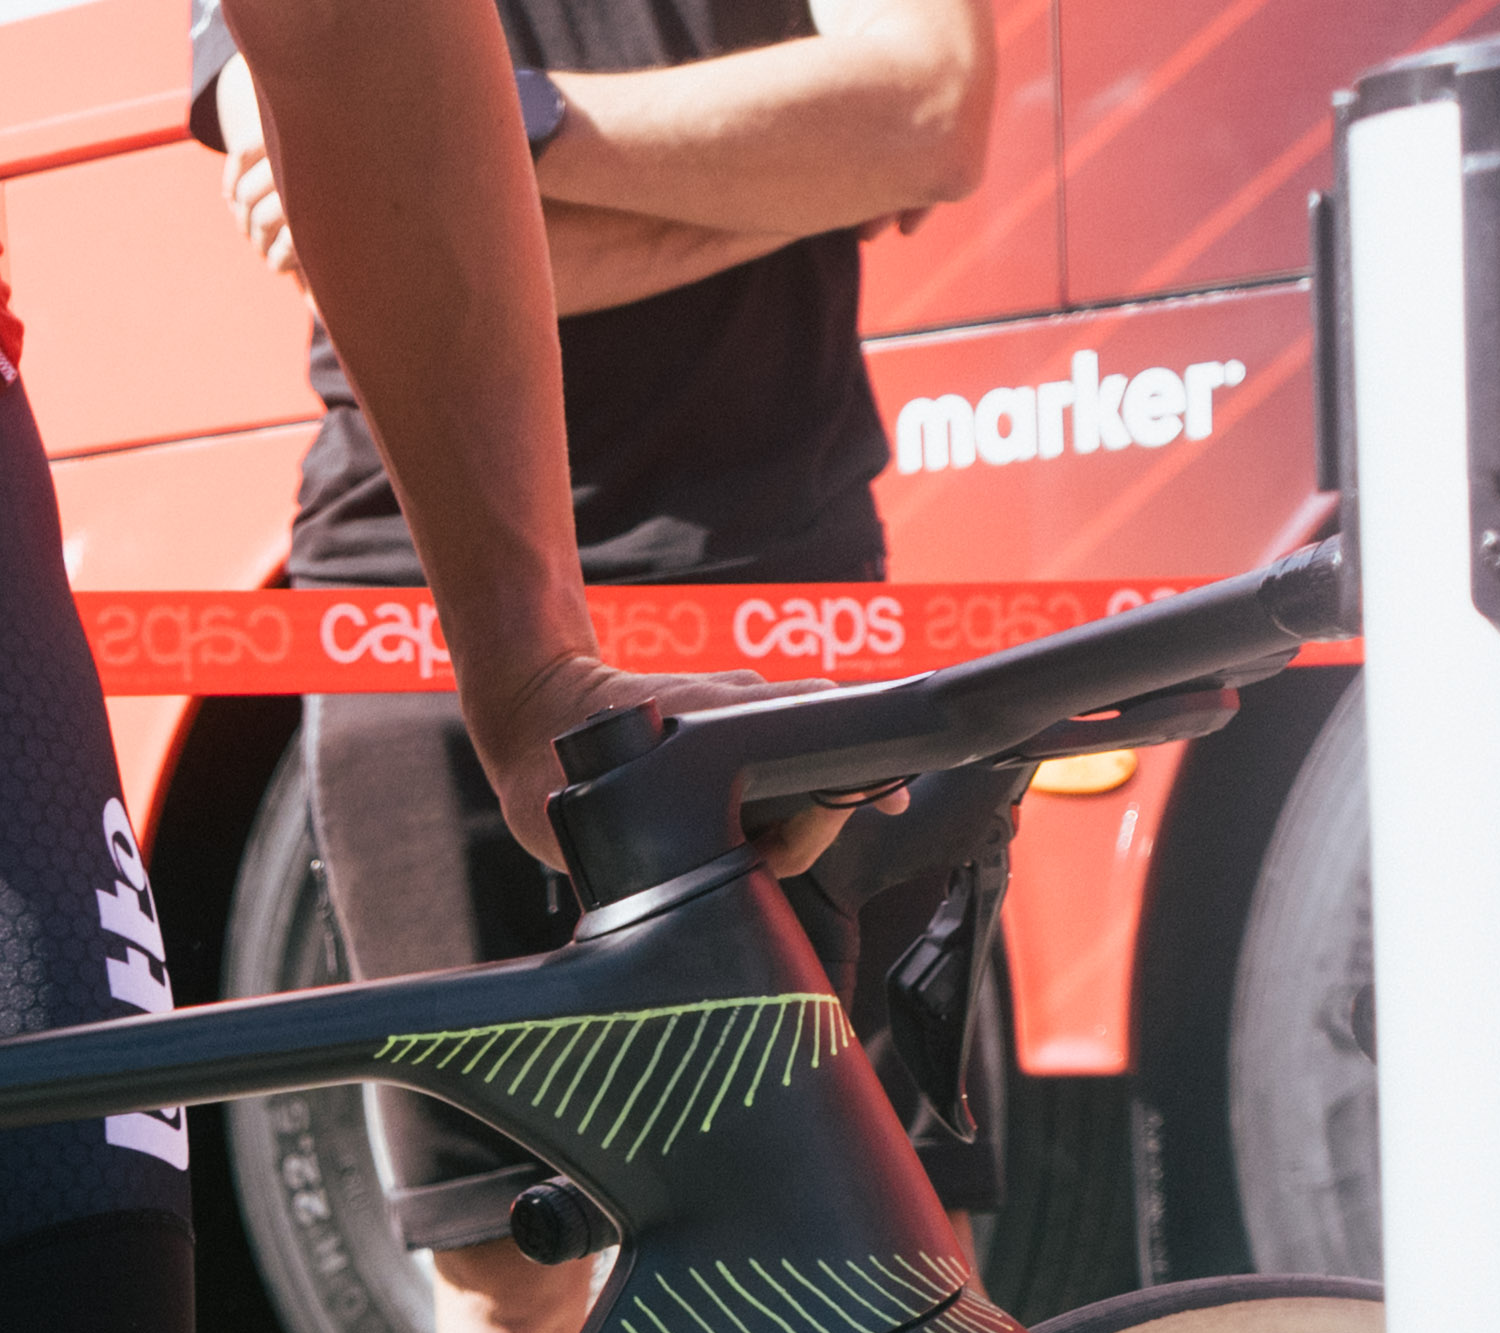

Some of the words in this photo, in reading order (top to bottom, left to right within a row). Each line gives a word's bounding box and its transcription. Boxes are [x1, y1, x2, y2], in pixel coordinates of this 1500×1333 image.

[320, 602, 449, 678] cap
[733, 596, 905, 673] caps
[96, 797, 190, 1172] ltto
